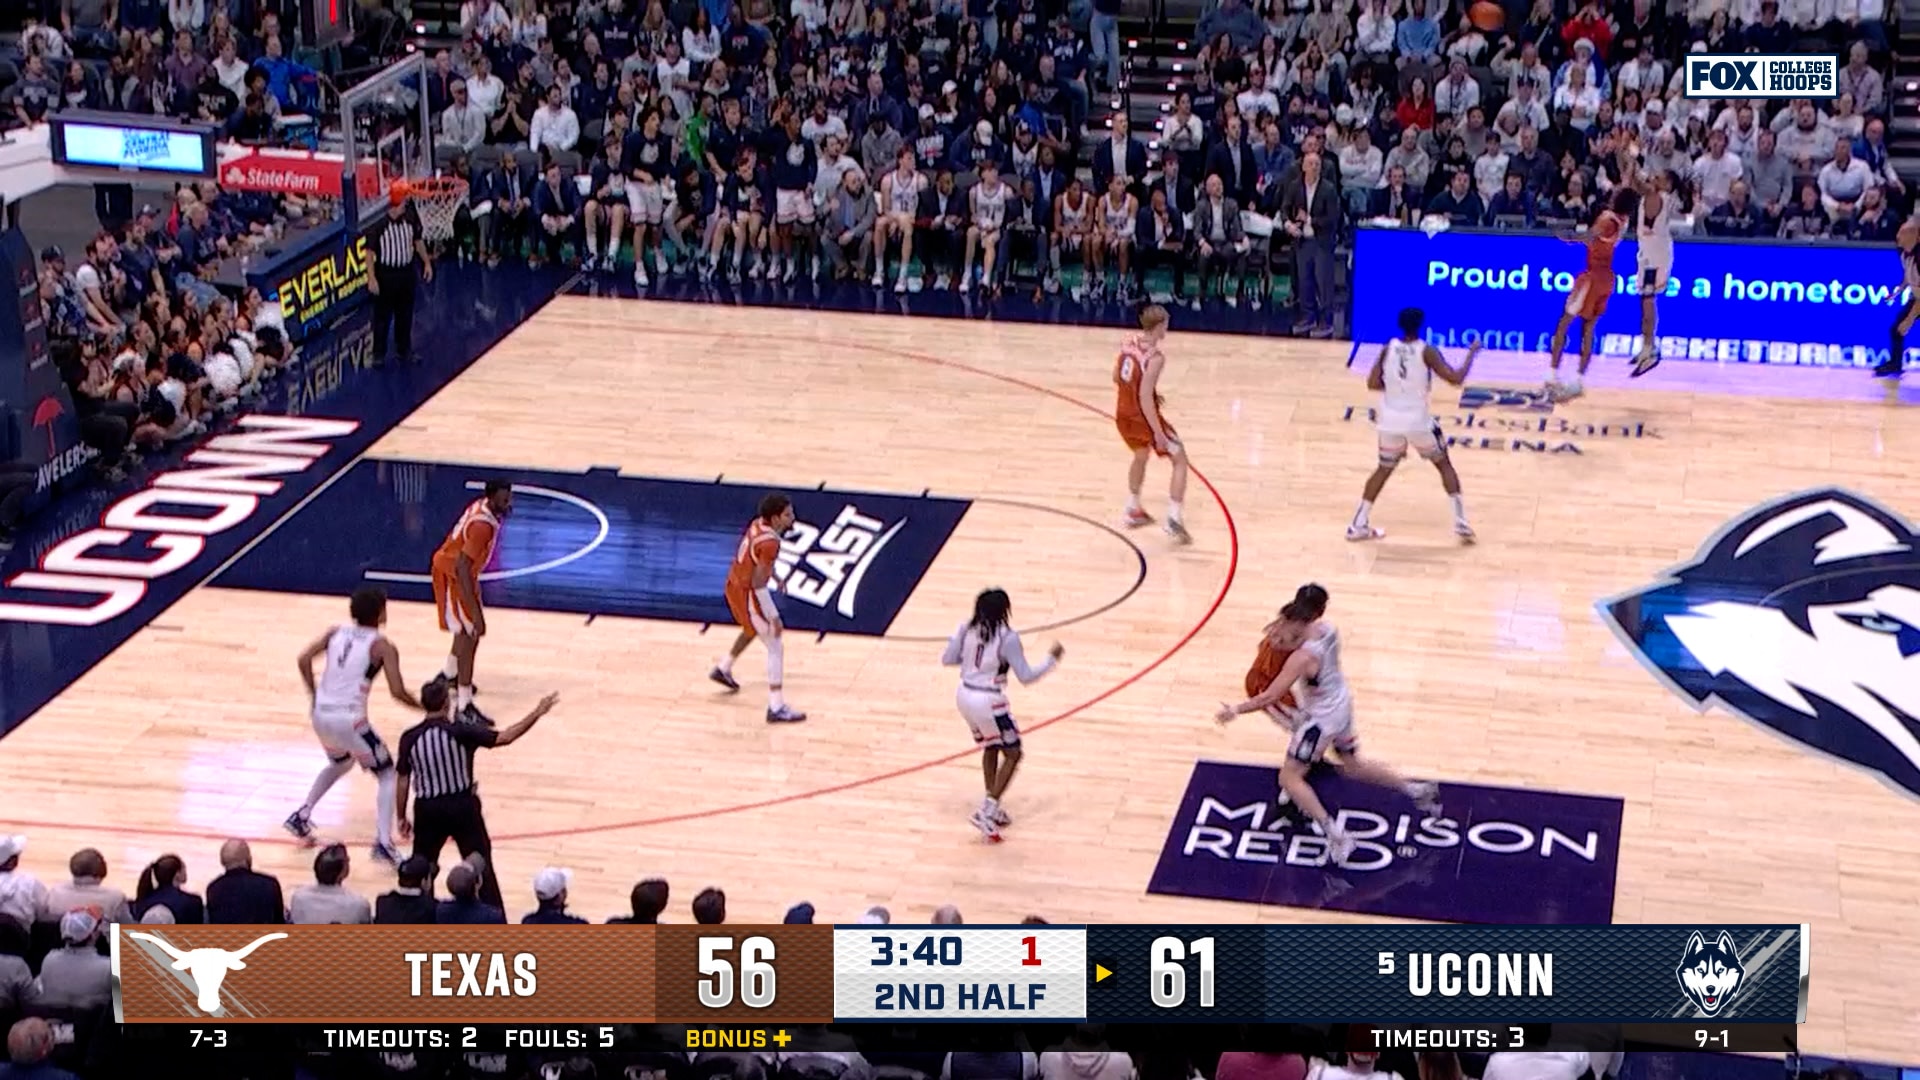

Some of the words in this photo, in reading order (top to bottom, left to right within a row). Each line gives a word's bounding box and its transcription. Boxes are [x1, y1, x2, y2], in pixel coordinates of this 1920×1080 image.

[278, 234, 369, 320] EVERLAS
[1427, 260, 1529, 290] Proud
[1539, 267, 1575, 292] to
[1691, 277, 1712, 299] a
[34, 440, 87, 494] AVELERS
[1446, 436, 1584, 456] RENA
[0, 412, 361, 626] UCONN
[786, 504, 884, 608] EAST
